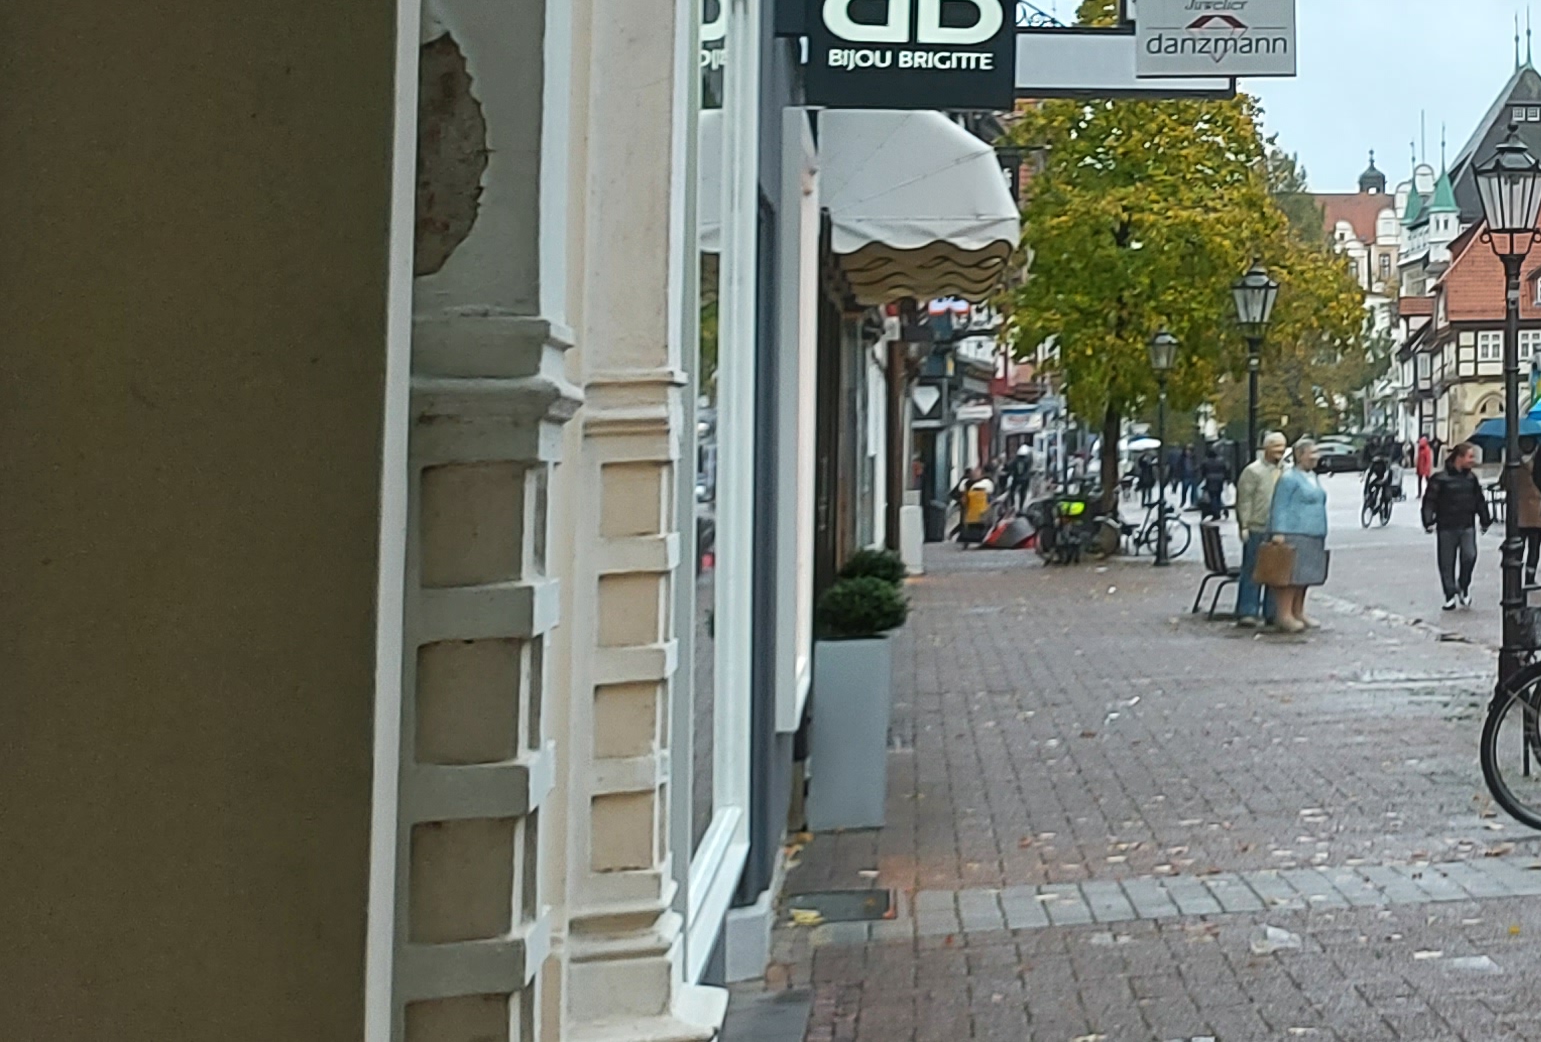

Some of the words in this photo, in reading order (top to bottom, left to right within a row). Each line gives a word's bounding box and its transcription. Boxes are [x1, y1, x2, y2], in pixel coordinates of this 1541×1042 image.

[1146, 32, 1288, 55] danzmann
[828, 48, 892, 71] BIJOU
[898, 51, 995, 71] BRIGITTE
